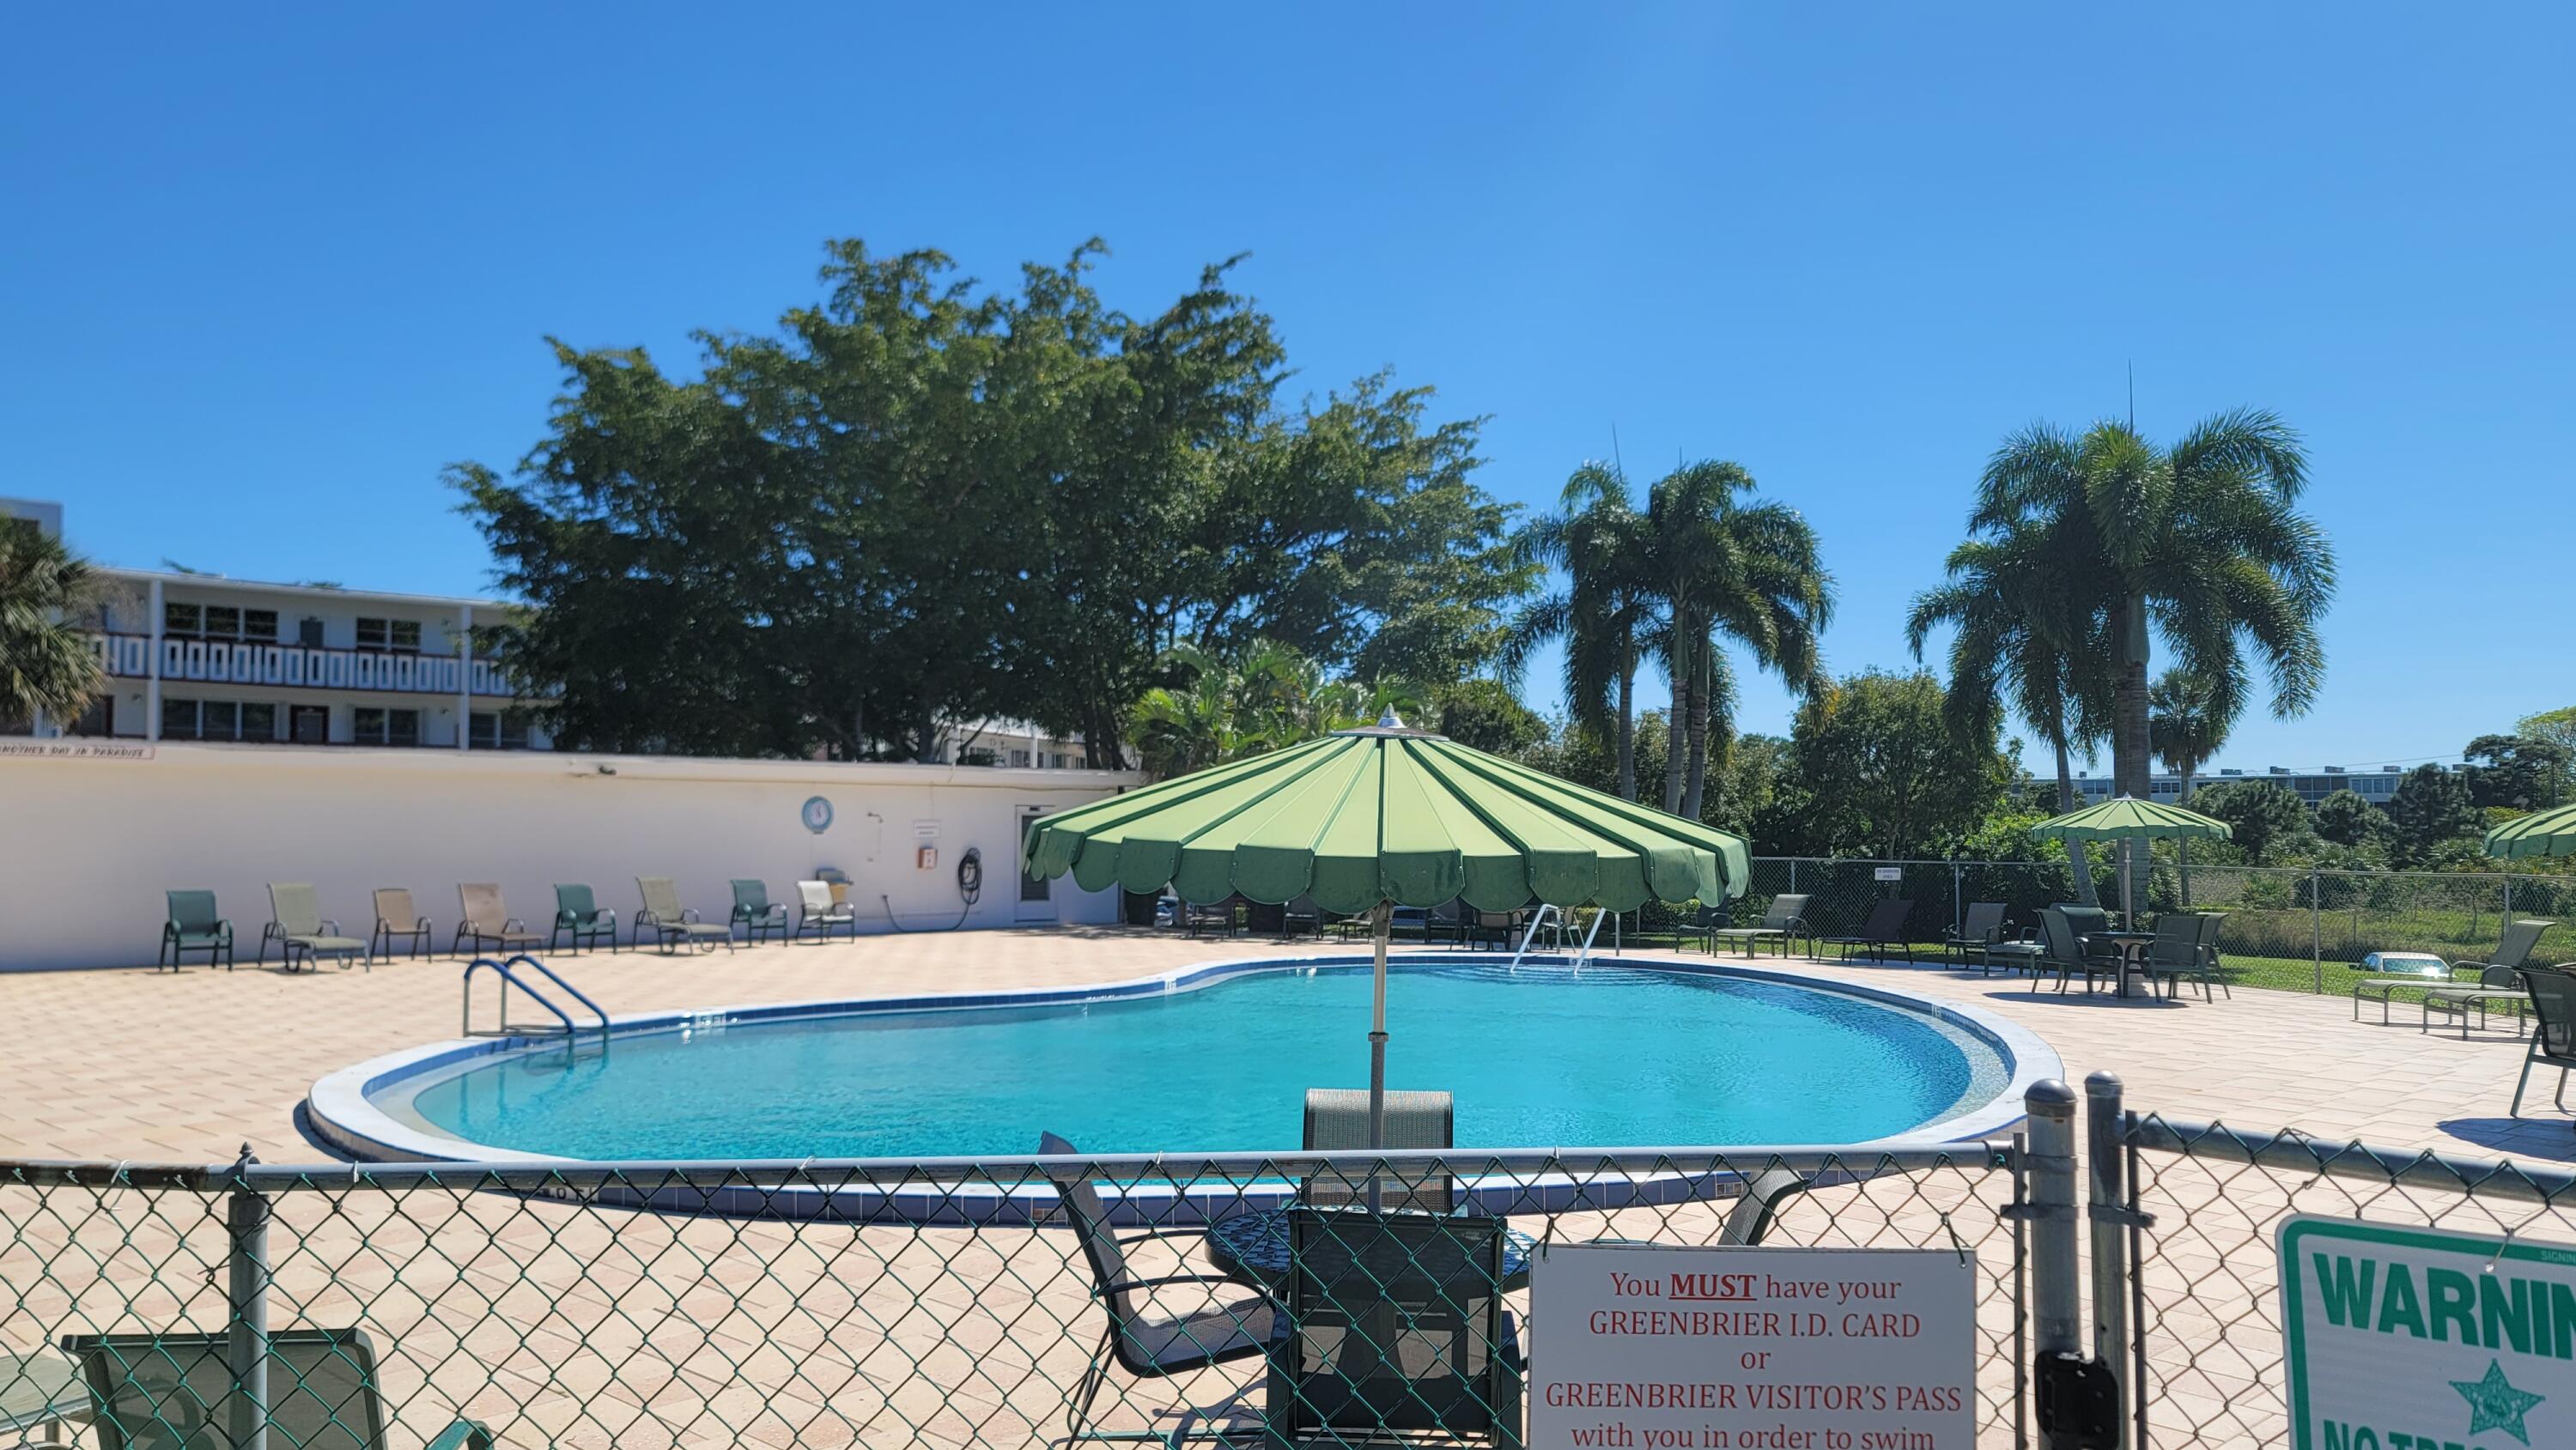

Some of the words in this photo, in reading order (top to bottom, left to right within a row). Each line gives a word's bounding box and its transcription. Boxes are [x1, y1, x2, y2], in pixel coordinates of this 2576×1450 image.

[93, 749, 146, 757] PARADISE
[1610, 1272, 1661, 1297] You
[1669, 1272, 1758, 1301] MUST
[1766, 1274, 1829, 1299] have
[1837, 1278, 1901, 1306] your
[1589, 1310, 1781, 1337] GREENBRIER
[1789, 1313, 1833, 1338] I.D.
[1842, 1313, 1921, 1338] CARD
[1740, 1351, 1771, 1370] or
[1546, 1382, 1737, 1409] GREENBRIER
[1747, 1384, 1887, 1411] VISITOR'S
[1896, 1386, 1962, 1411] PASS
[1571, 1423, 1634, 1448] with
[1642, 1429, 1694, 1450] you
[1703, 1424, 1730, 1448] in
[1738, 1424, 1817, 1450] order
[1826, 1428, 1852, 1450] to
[1862, 1427, 1935, 1450] swim
